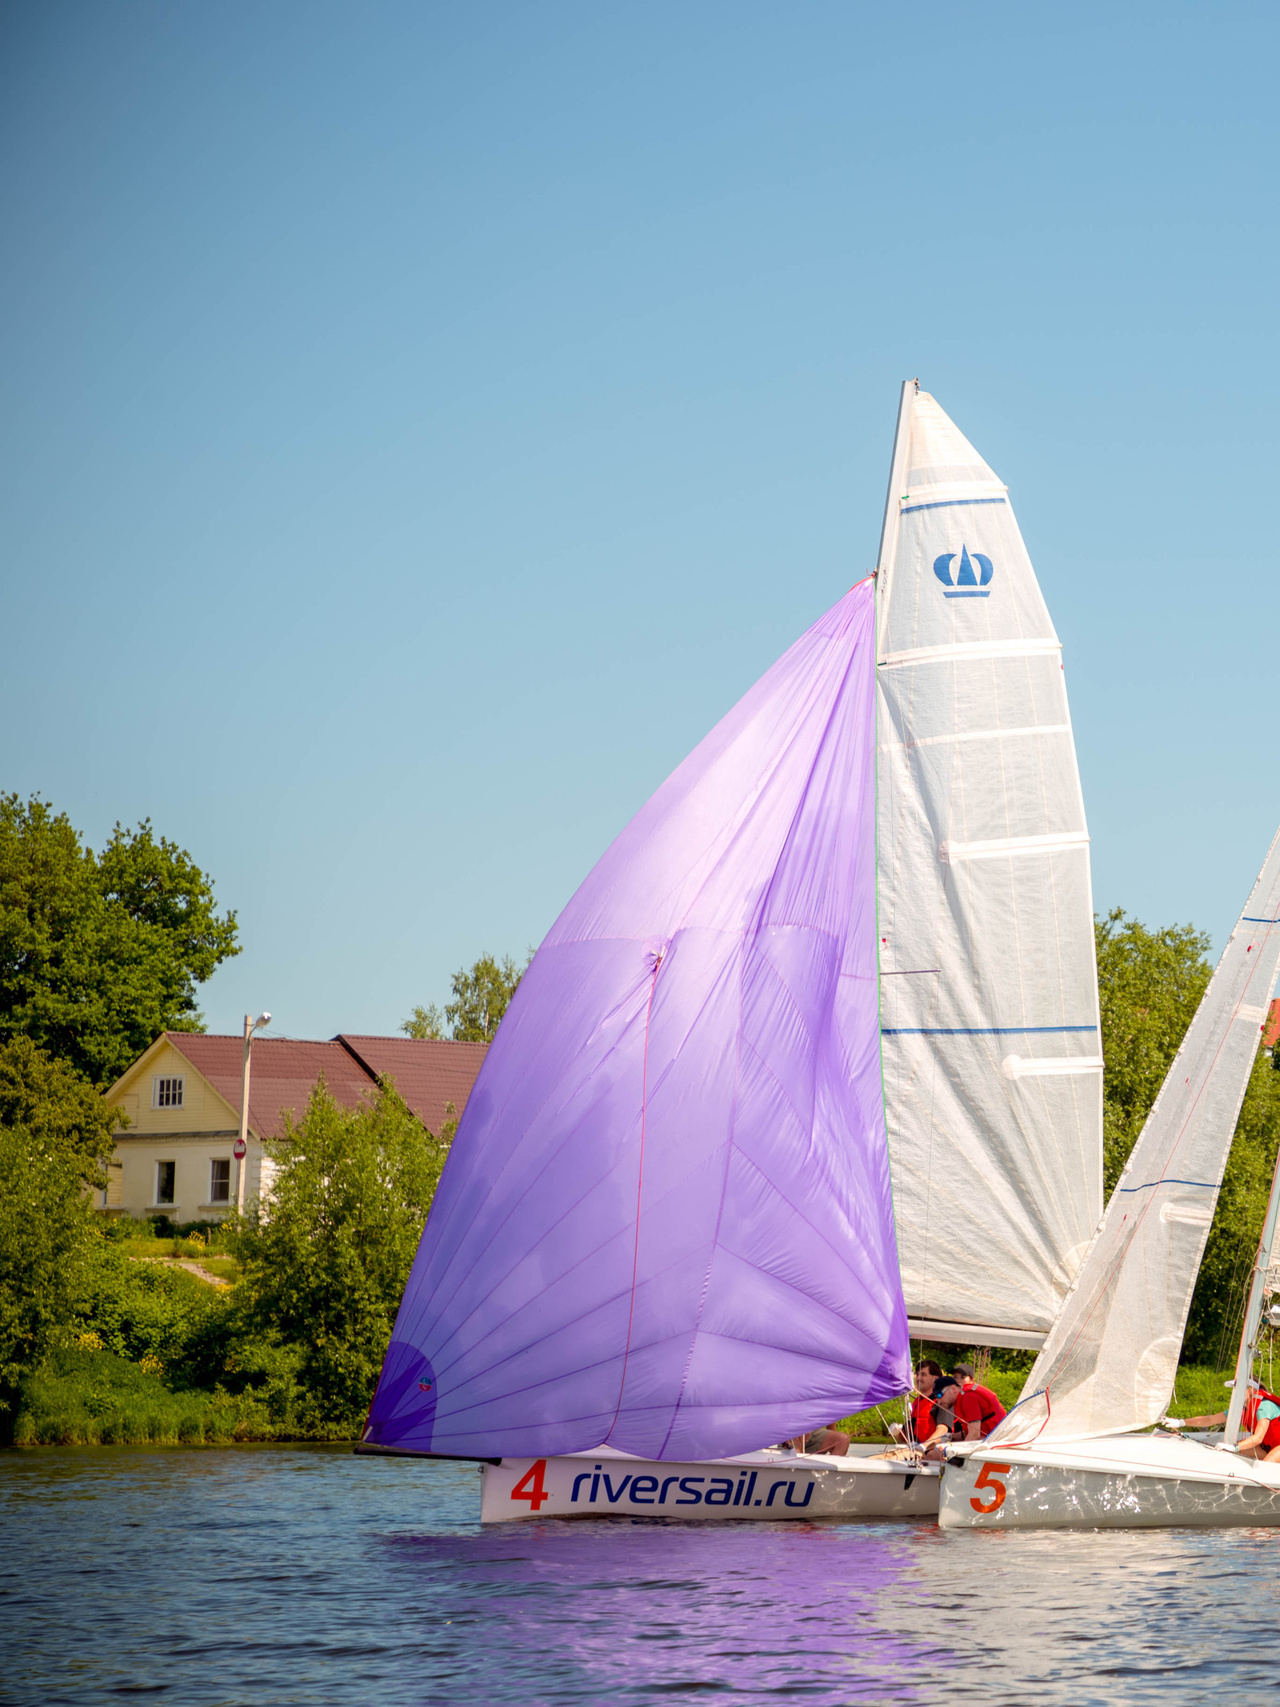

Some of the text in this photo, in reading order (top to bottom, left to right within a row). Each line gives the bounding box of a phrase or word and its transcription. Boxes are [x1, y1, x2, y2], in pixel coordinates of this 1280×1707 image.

[510, 1459, 815, 1511] 4 riversail.ru
[969, 1461, 1012, 1514] 5
